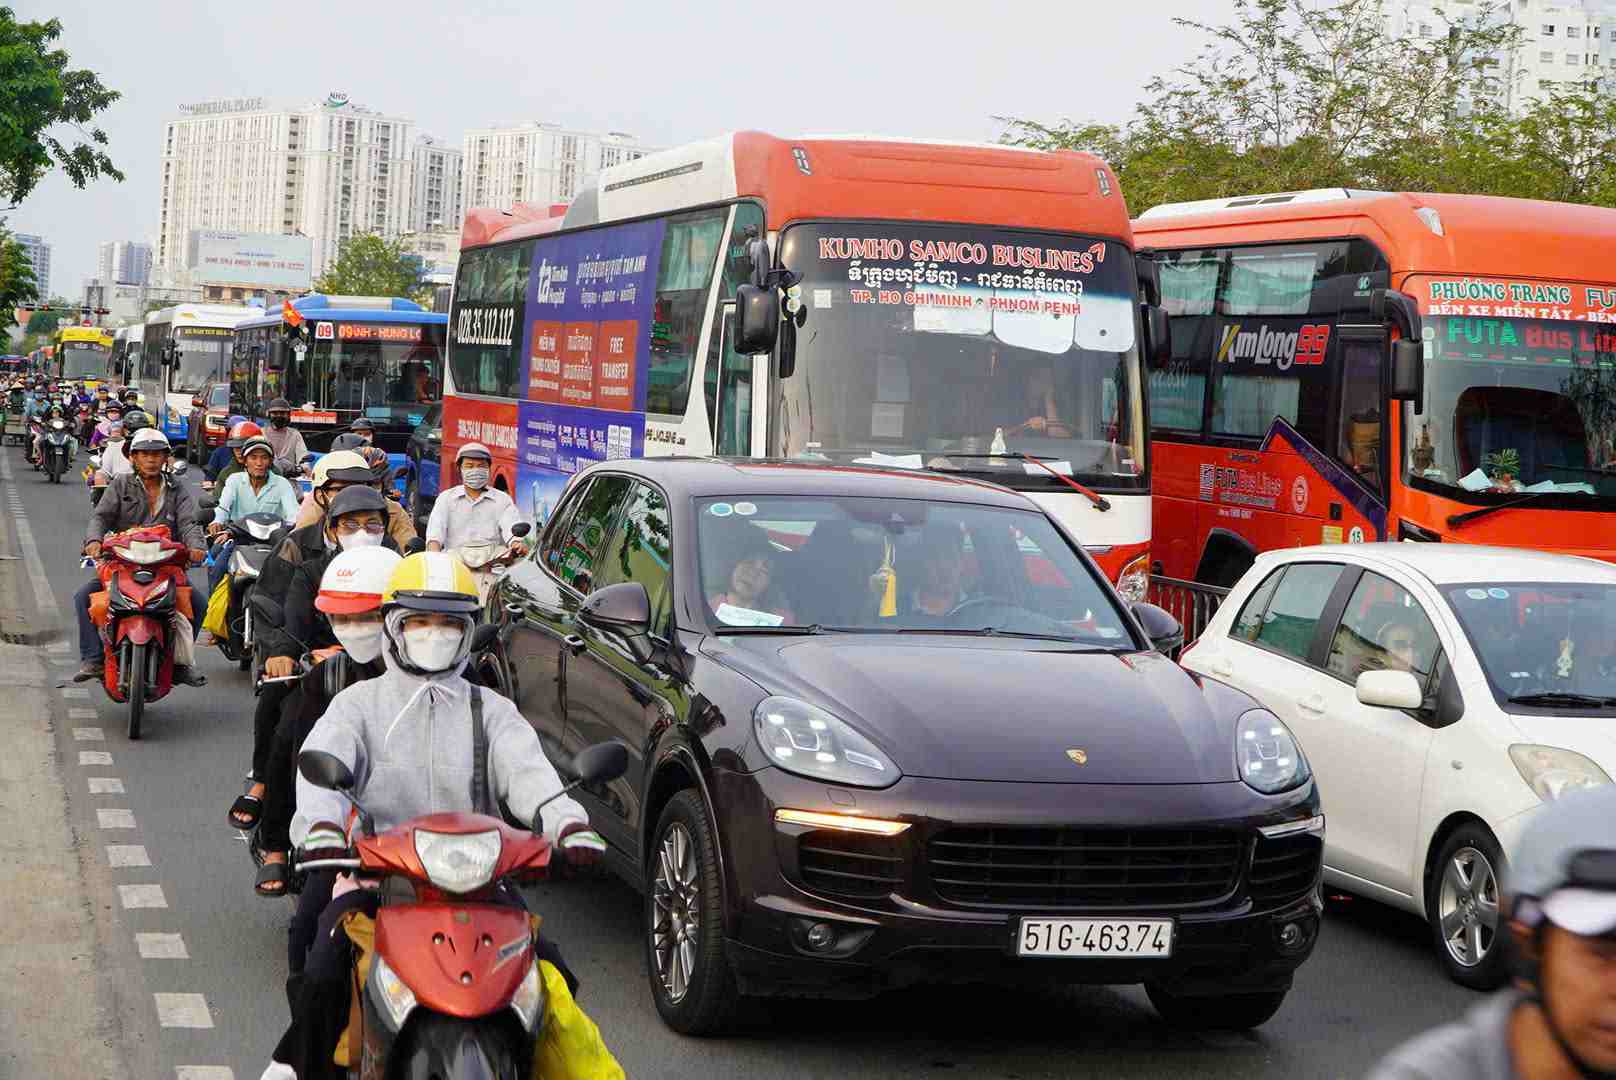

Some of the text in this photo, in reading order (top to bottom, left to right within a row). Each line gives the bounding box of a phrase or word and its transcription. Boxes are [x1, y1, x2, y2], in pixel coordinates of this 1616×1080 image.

[818, 237, 1095, 274] KUMHO SAMCO BUSLINES
[850, 289, 876, 304] TP.
[879, 290, 902, 304] HO
[936, 293, 973, 308] MINH
[990, 297, 1041, 313] PHNOM
[1044, 301, 1081, 315] PENH
[1430, 279, 1507, 301] PHƯƠNG
[1510, 284, 1572, 304] TRANG
[1467, 304, 1490, 316] XE
[317, 324, 333, 337] 09
[1447, 319, 1520, 346] FUTA
[1525, 325, 1573, 349] Bus
[1025, 923, 1165, 952] 51G-463.74
